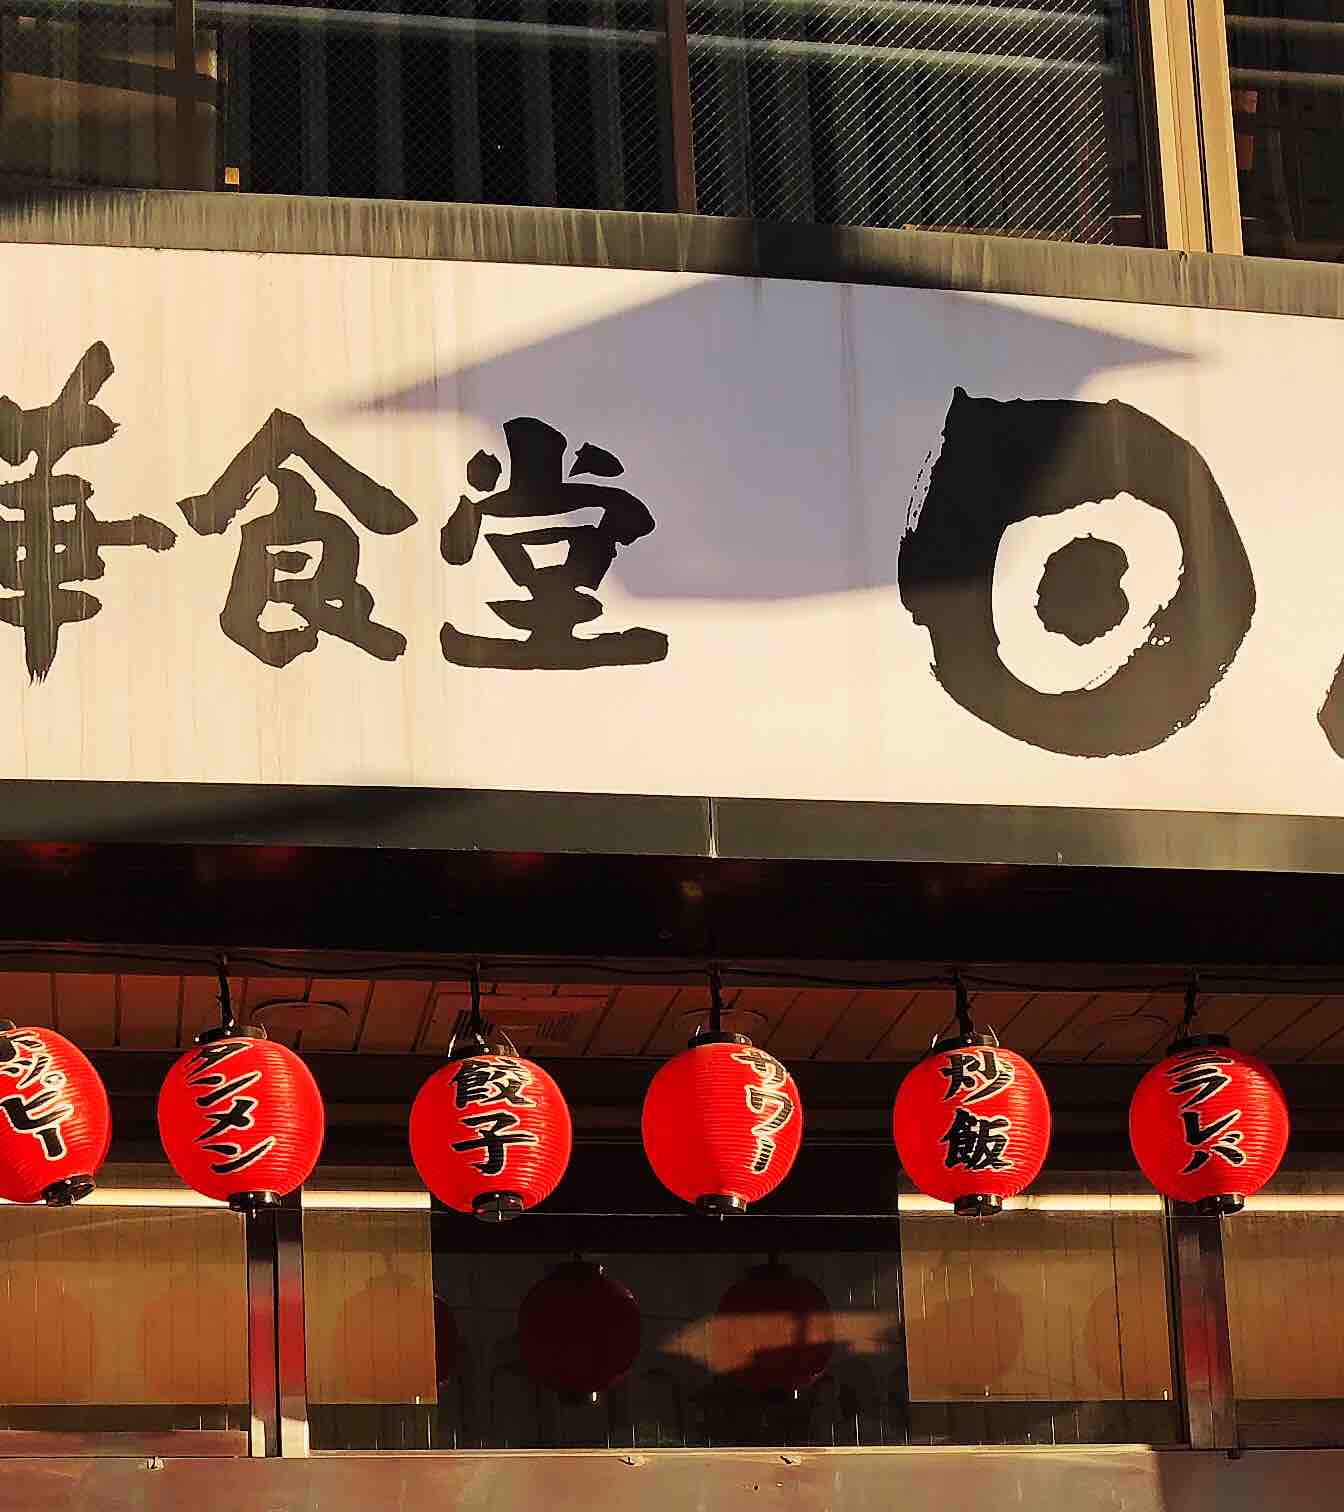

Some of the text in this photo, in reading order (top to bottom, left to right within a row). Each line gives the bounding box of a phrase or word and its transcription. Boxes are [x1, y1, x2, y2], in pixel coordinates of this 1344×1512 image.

[185, 1040, 276, 1174] タンメン
[451, 1058, 539, 1177] 餃子
[729, 1047, 795, 1175] サワー
[939, 1049, 1016, 1173] 炒飯
